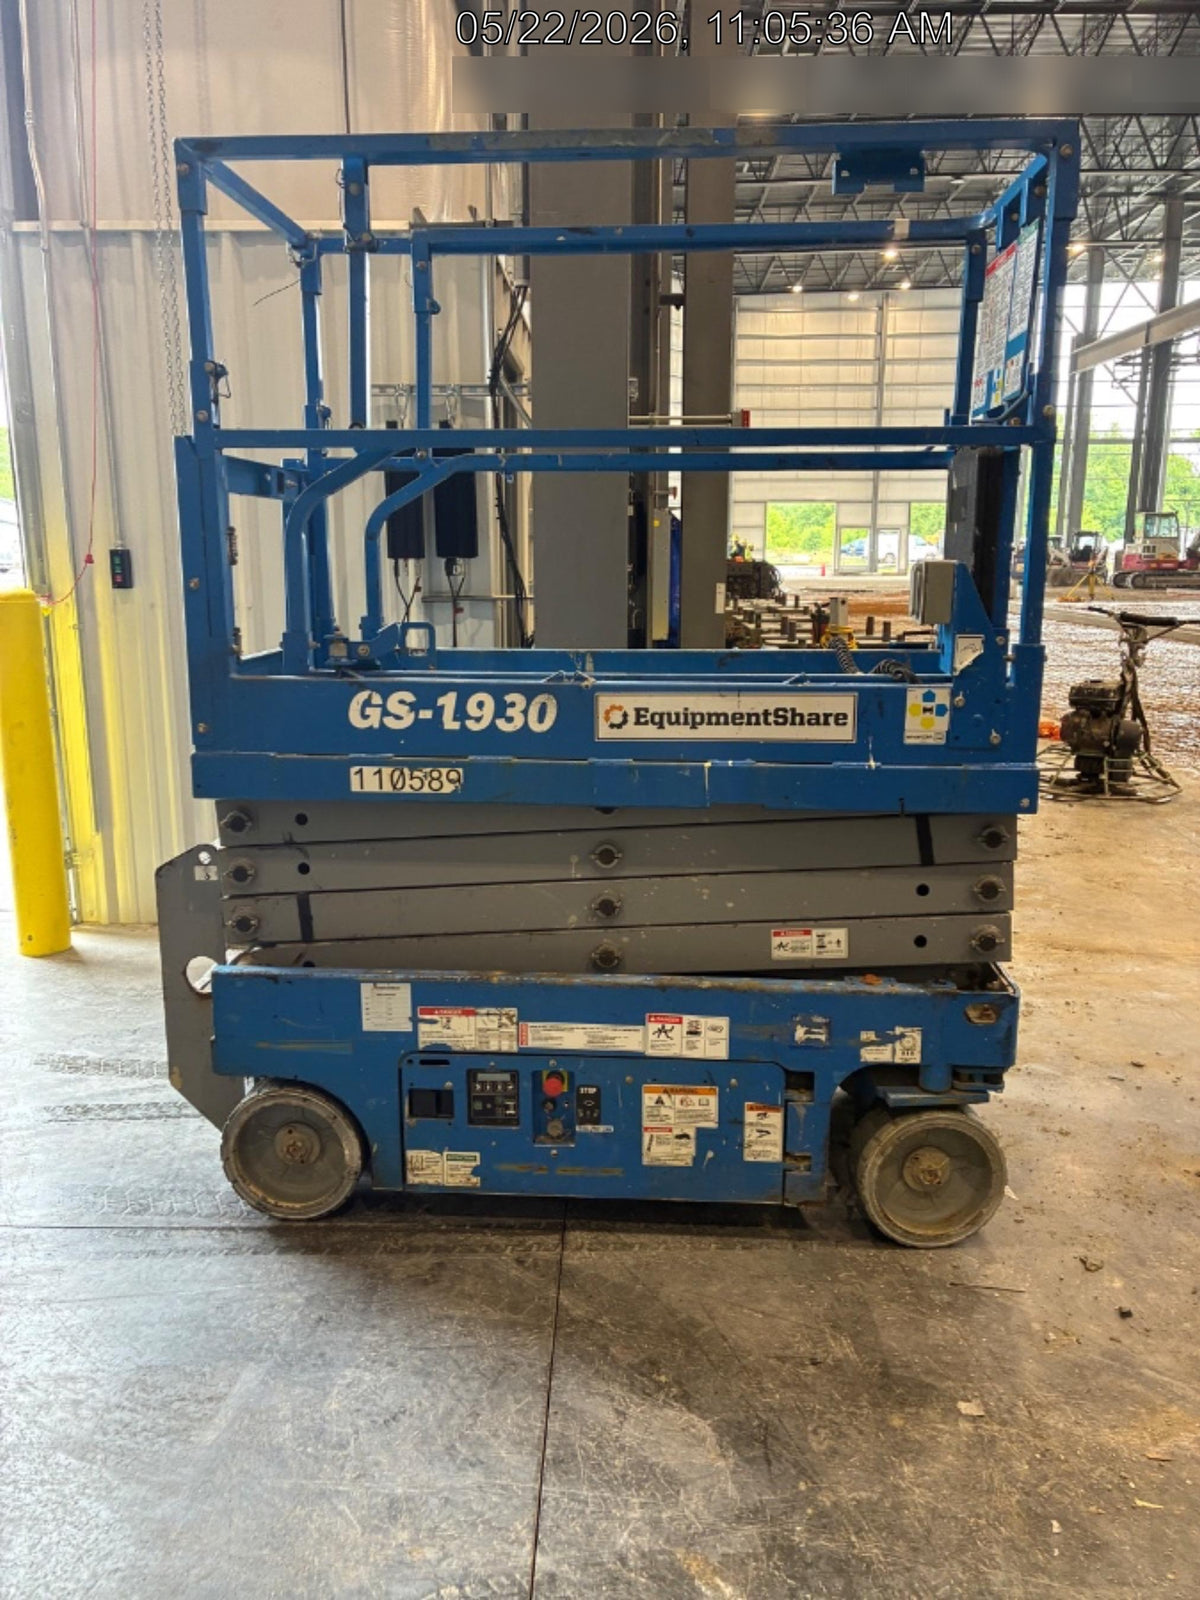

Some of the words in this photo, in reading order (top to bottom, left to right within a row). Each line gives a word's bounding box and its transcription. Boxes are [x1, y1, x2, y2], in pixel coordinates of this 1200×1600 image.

[348, 689, 558, 733] GS-1930
[633, 707, 849, 730] EquipmentShare
[353, 767, 462, 792] 110589
